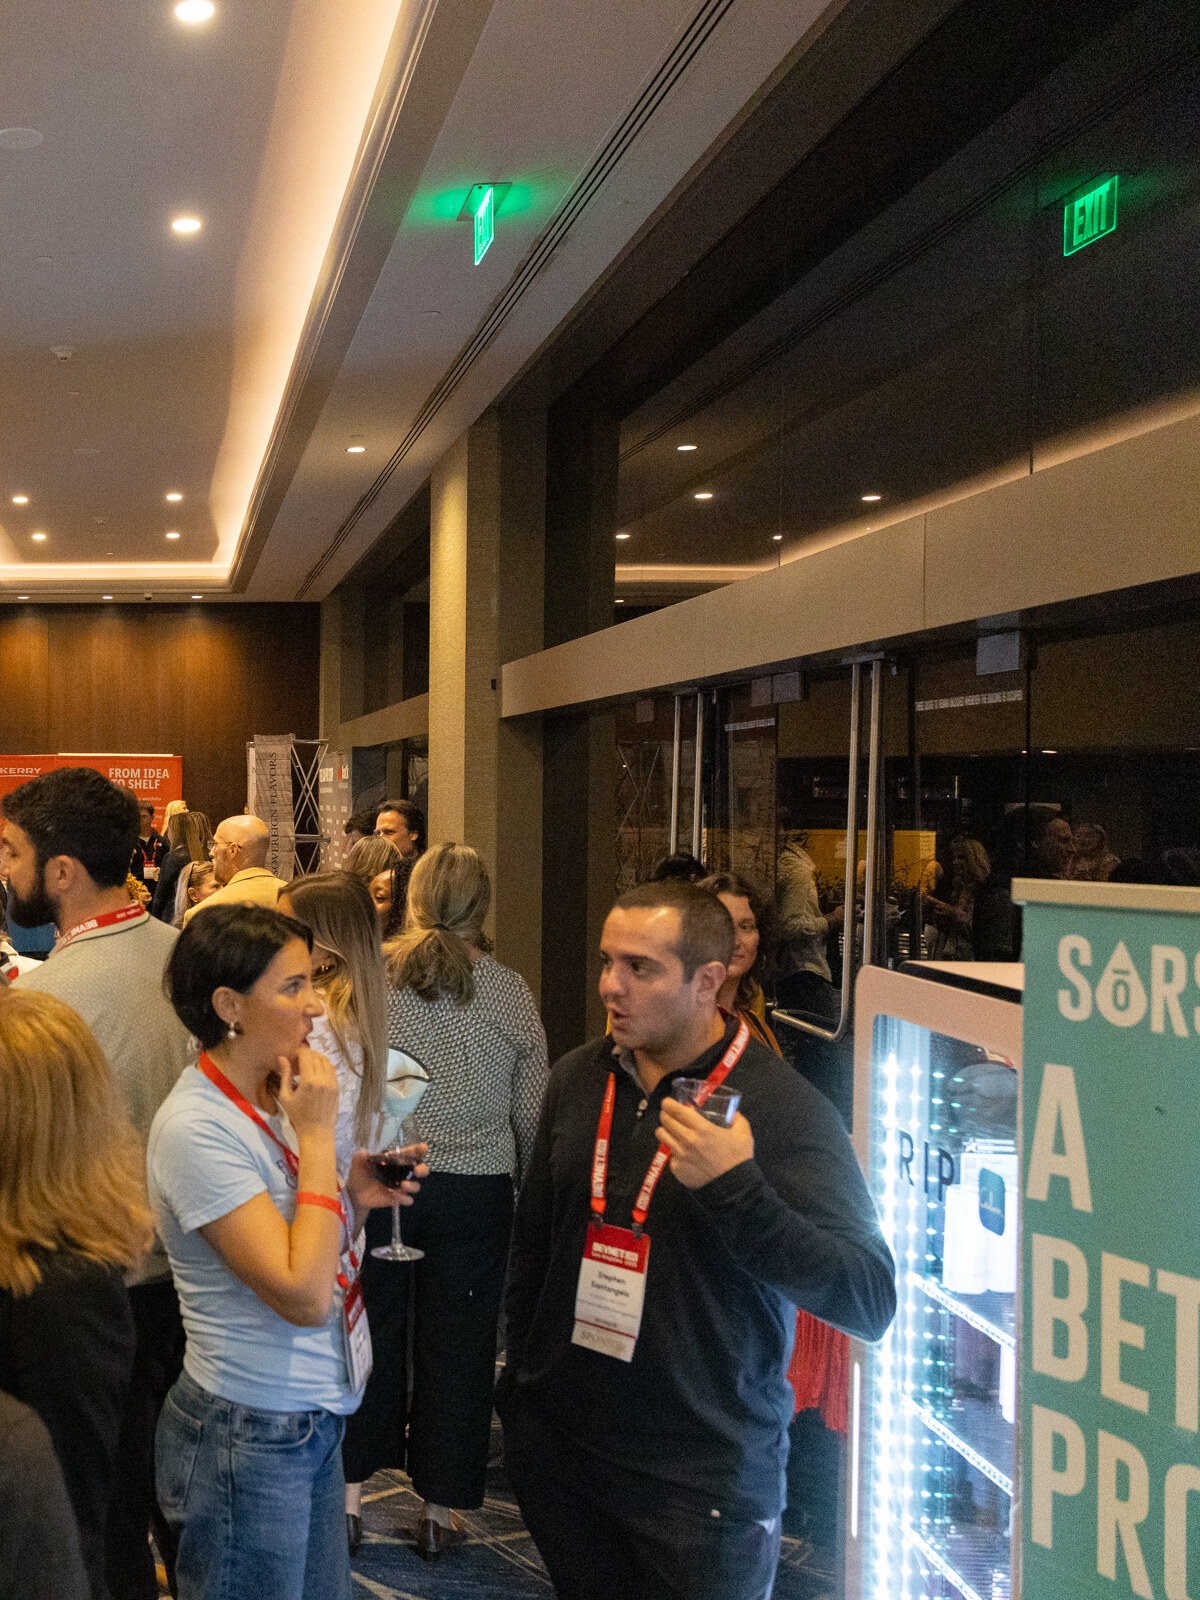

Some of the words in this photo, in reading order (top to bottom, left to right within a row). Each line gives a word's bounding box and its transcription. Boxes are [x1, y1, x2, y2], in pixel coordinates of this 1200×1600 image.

[1072, 181, 1111, 247] EXIT
[0, 767, 42, 775] KERRY
[108, 768, 141, 779] FROM
[143, 769, 170, 779] IDEA
[128, 779, 161, 790] SHELF
[269, 751, 278, 805] FLAVORS
[1026, 1062, 1093, 1214] A
